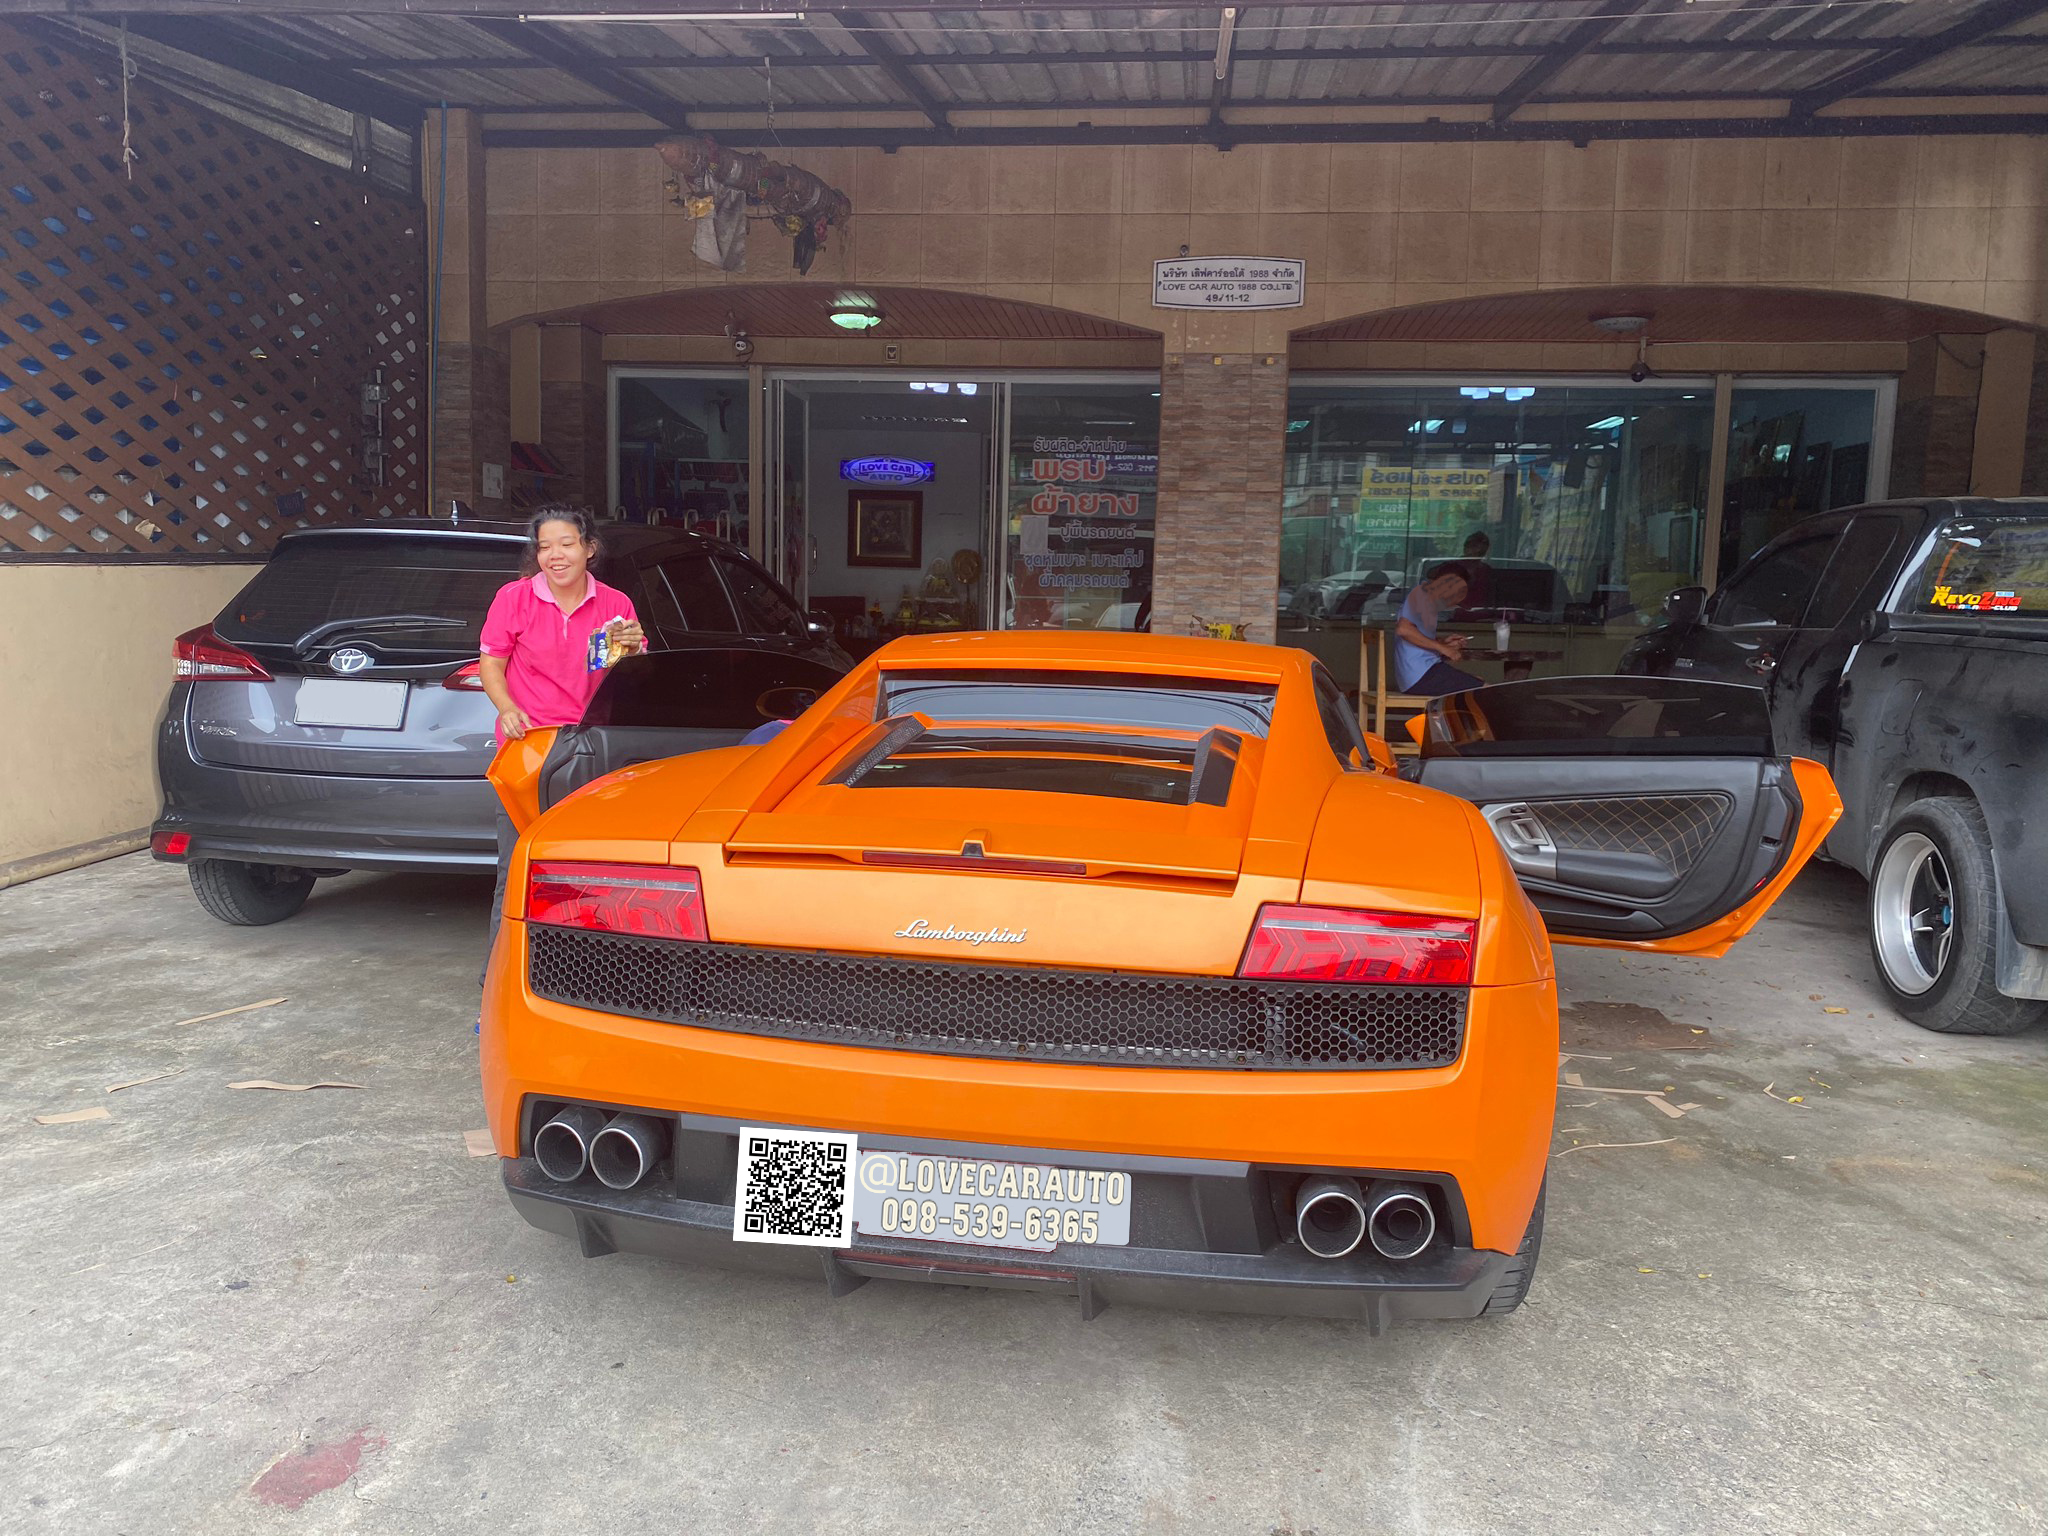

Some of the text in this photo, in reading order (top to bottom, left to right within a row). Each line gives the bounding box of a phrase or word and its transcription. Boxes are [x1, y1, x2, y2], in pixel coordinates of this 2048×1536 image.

[1162, 266, 1188, 278] บริษัท
[1249, 269, 1269, 278] 1988
[1272, 267, 1295, 278] จำกัด
[1162, 283, 1186, 291] LOVE
[1189, 283, 1208, 291] CAR
[1210, 283, 1235, 291] AUTO
[1237, 283, 1257, 291] 1988
[1205, 293, 1250, 302] 49/11-12
[1033, 436, 1127, 453] รับผลิต-จำหน่าย
[861, 463, 912, 473] LOVE CAR
[1032, 459, 1106, 482] พรม
[869, 473, 904, 481] AUTO
[1031, 483, 1139, 516] ผ้ายาง
[1060, 519, 1136, 542] ปูพื้นรถยนต์
[895, 919, 1027, 946] Lamborghini
